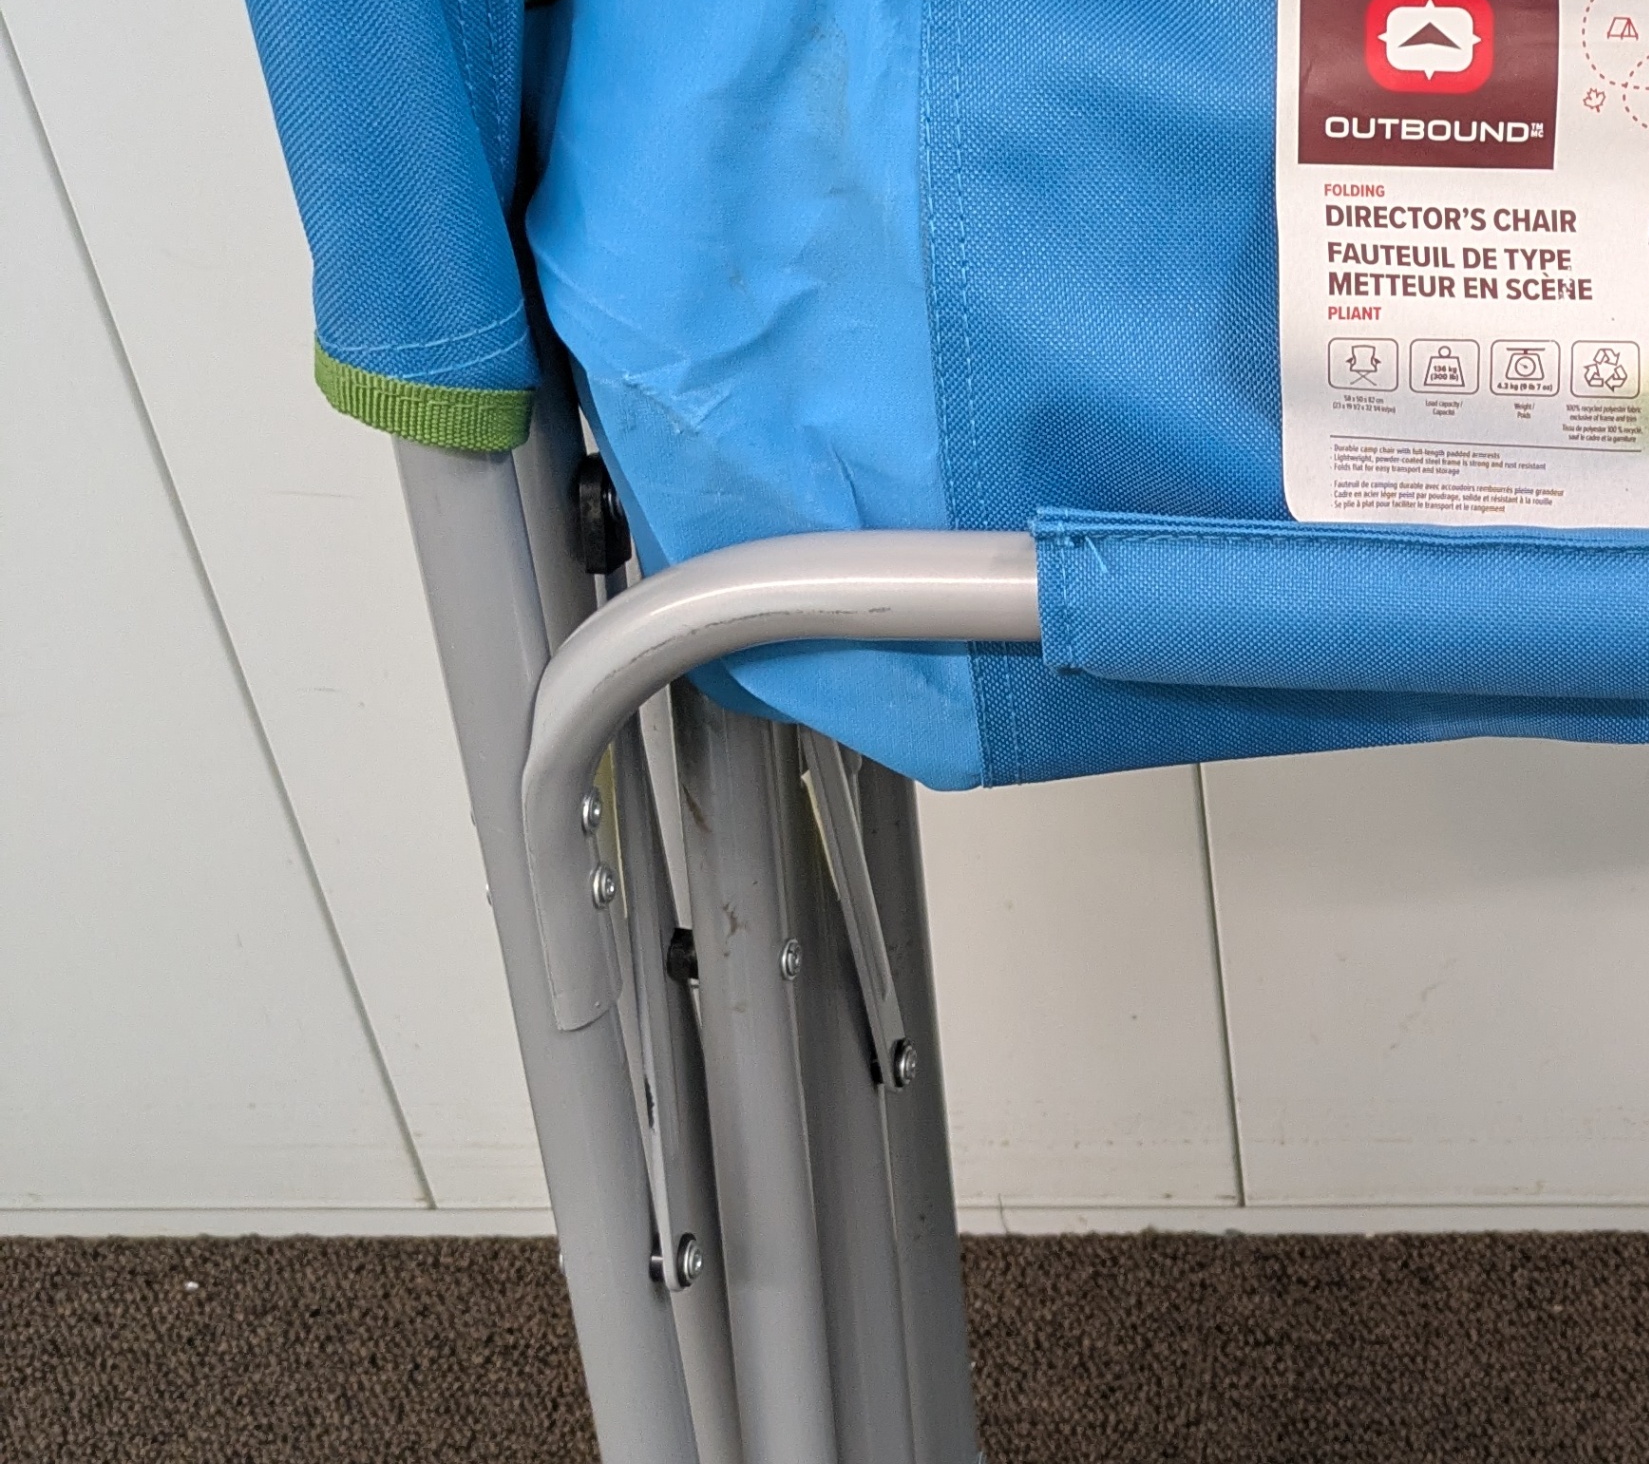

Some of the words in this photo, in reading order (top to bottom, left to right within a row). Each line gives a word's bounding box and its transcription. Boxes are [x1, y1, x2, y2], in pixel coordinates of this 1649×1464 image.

[1325, 117, 1529, 143] OUTBOUND
[1325, 184, 1385, 197] FOLDING
[1326, 205, 1486, 231] DIRECTOR'S
[1494, 209, 1576, 232] CHAIR
[1328, 242, 1455, 268] FAUTEUIL
[1463, 248, 1497, 270] DE
[1504, 249, 1571, 270] TYPE
[1329, 272, 1455, 298] METTEUR
[1464, 278, 1498, 299] EN
[1506, 273, 1593, 300] SCÈNE
[1328, 307, 1381, 320] PLIANT
[1334, 444, 1358, 452] Durable
[1380, 446, 1394, 454] chair
[1442, 458, 1460, 466] frame
[1470, 460, 1489, 468] strong
[1392, 466, 1420, 474] transport
[1436, 467, 1459, 476] storage
[1334, 480, 1359, 488] Fauteuil
[1371, 483, 1397, 491] camping
[1344, 501, 1354, 509] plie
[1425, 502, 1454, 511] transport
